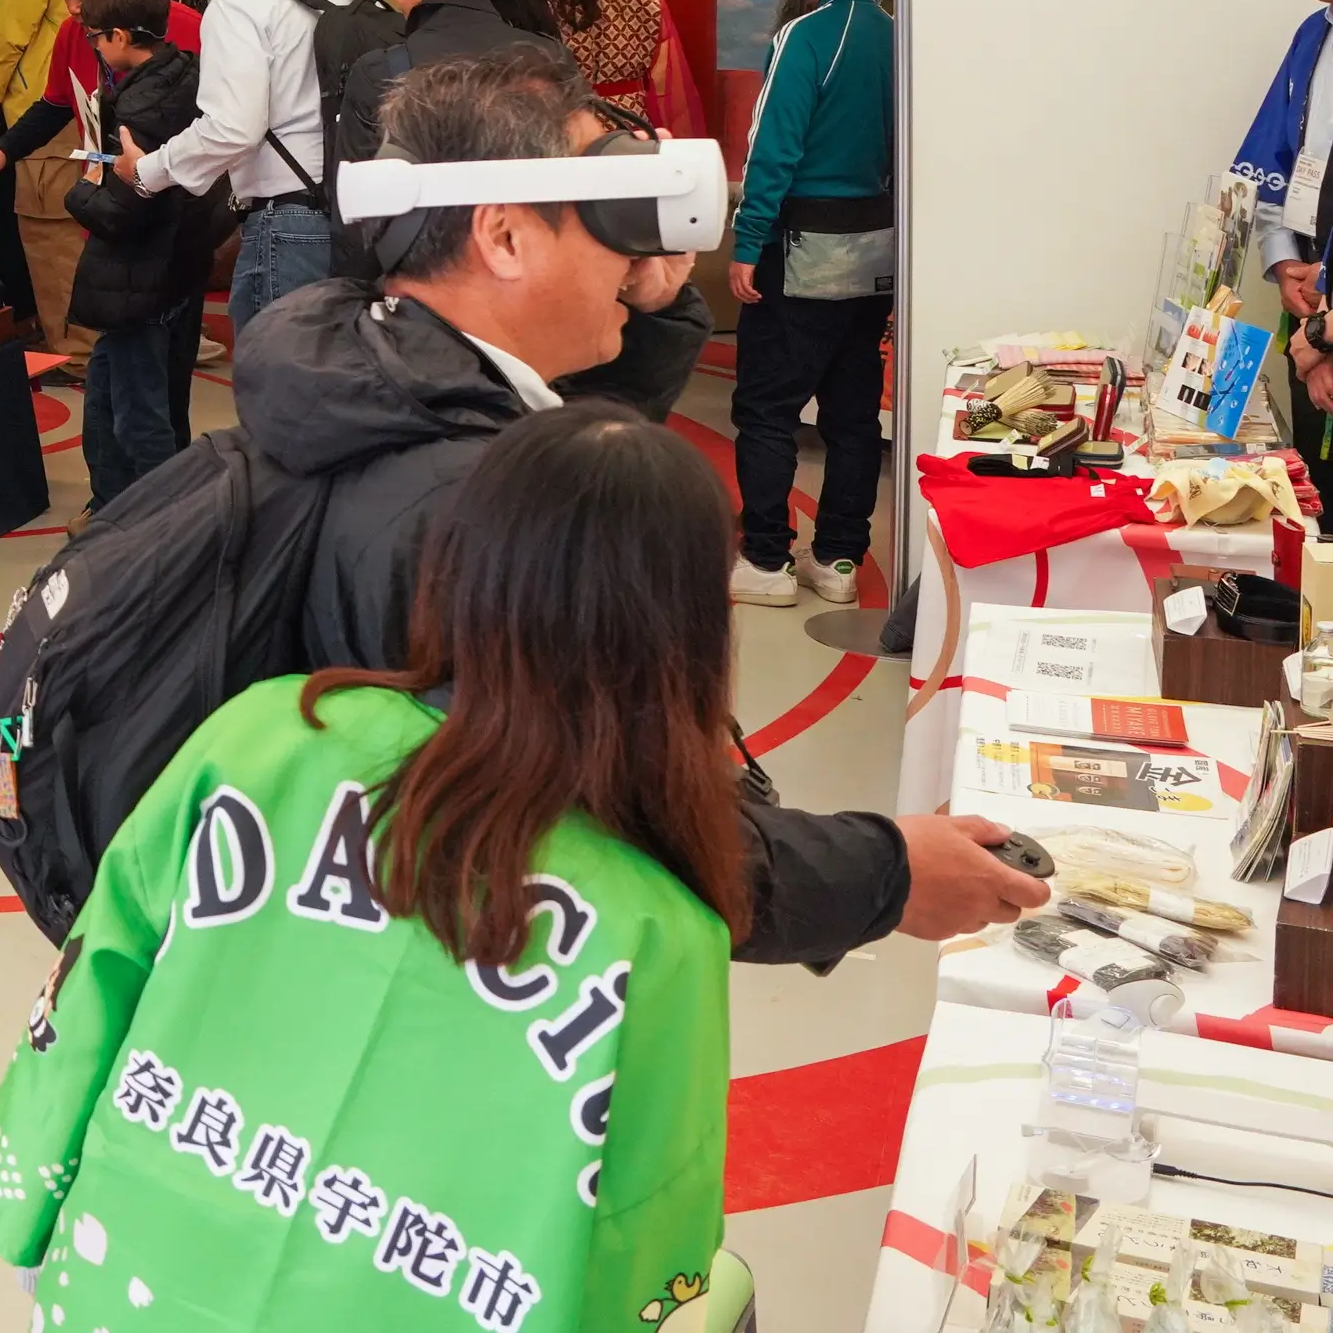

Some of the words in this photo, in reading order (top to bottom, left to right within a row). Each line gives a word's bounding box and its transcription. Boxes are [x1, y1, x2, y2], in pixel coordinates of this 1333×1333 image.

[112, 1050, 542, 1333] 奈良県宇陀市
